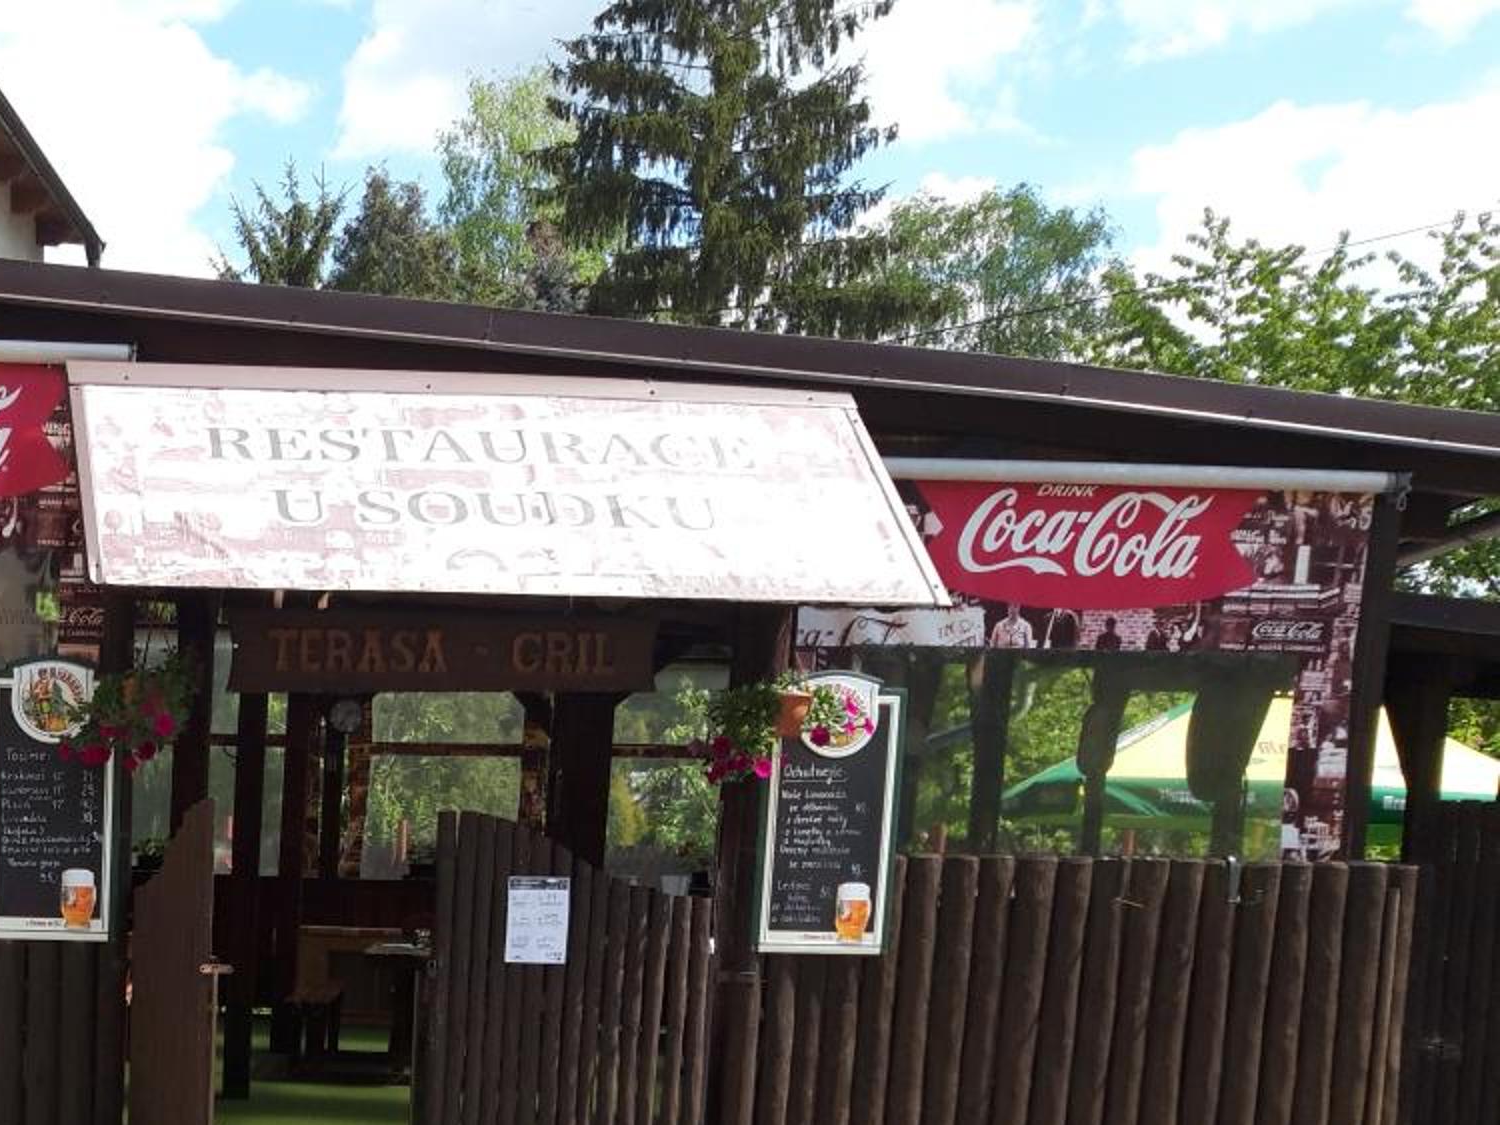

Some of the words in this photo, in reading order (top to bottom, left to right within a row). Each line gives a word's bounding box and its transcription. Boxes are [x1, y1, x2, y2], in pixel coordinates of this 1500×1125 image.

[205, 426, 757, 469] RESTAURACE
[270, 488, 324, 523] U
[356, 489, 716, 531] SOUDKU
[1037, 484, 1098, 498] DRINK
[957, 488, 1216, 579] Coca-Cola
[268, 629, 448, 674] TERASA
